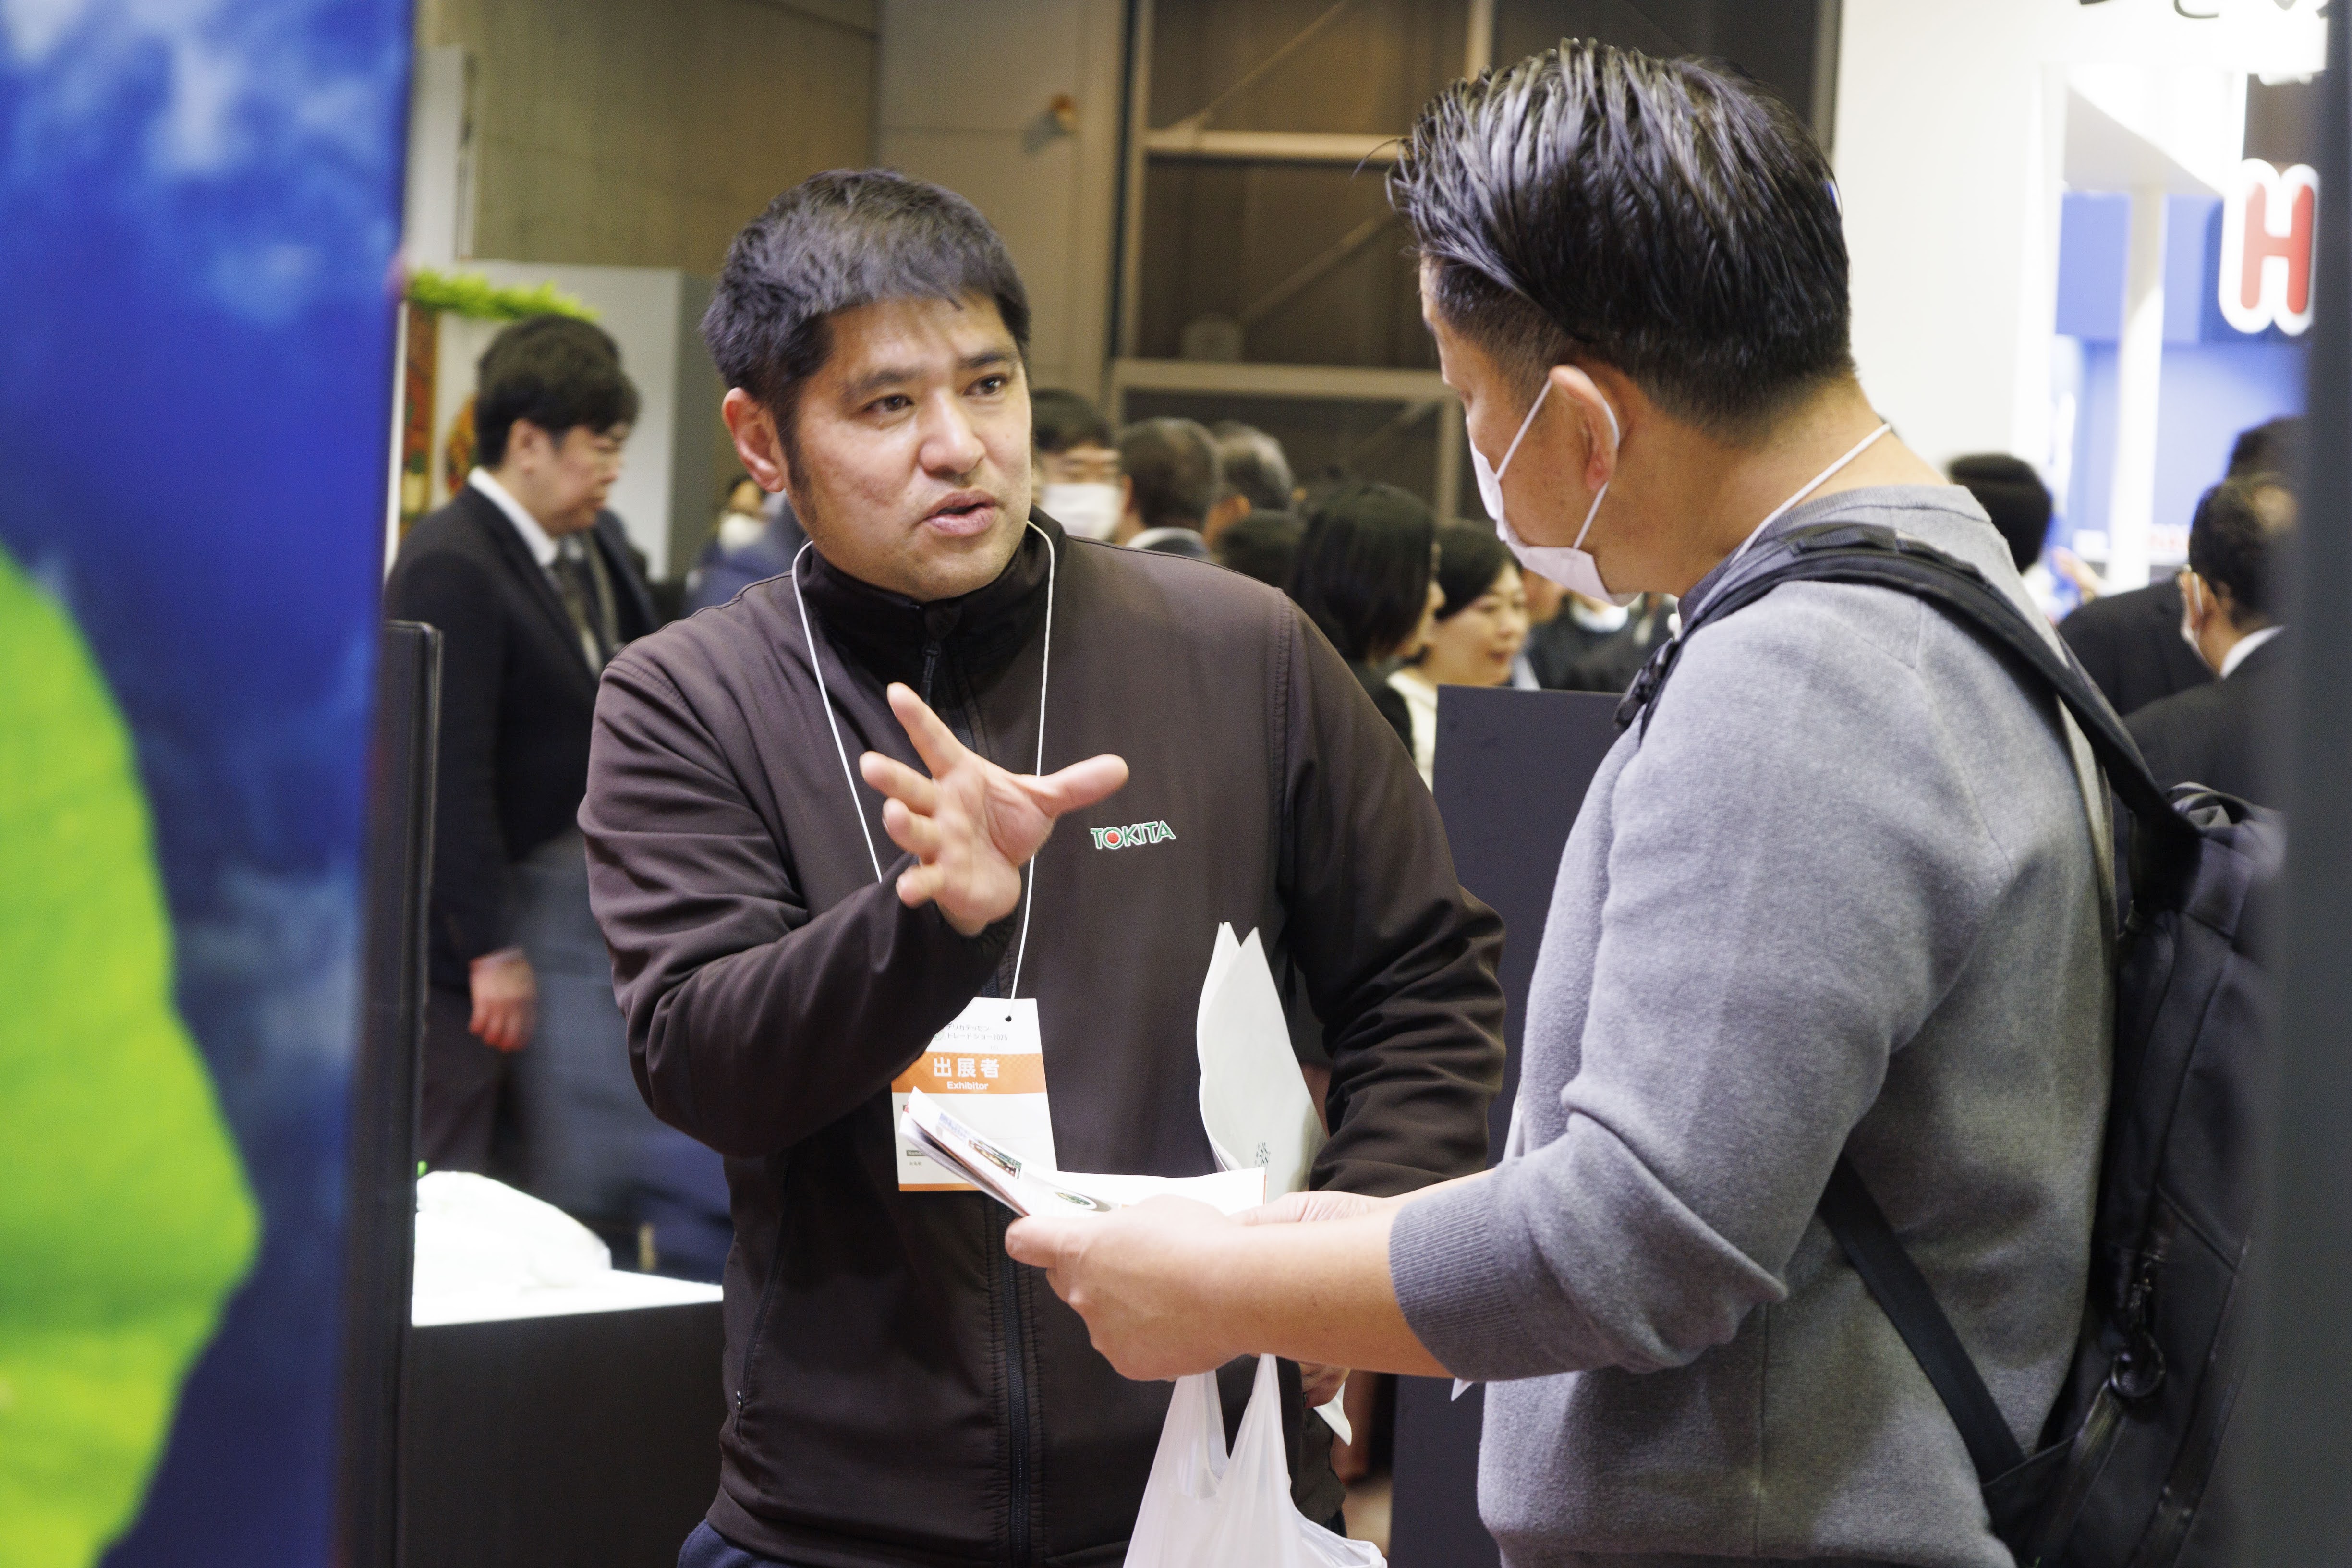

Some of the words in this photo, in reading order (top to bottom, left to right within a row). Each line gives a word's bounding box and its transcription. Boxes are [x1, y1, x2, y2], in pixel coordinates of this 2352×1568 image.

[1090, 820, 1176, 849] TOKITA
[934, 1057, 999, 1078] 出展者
[947, 1081, 989, 1090] Exhibitor
